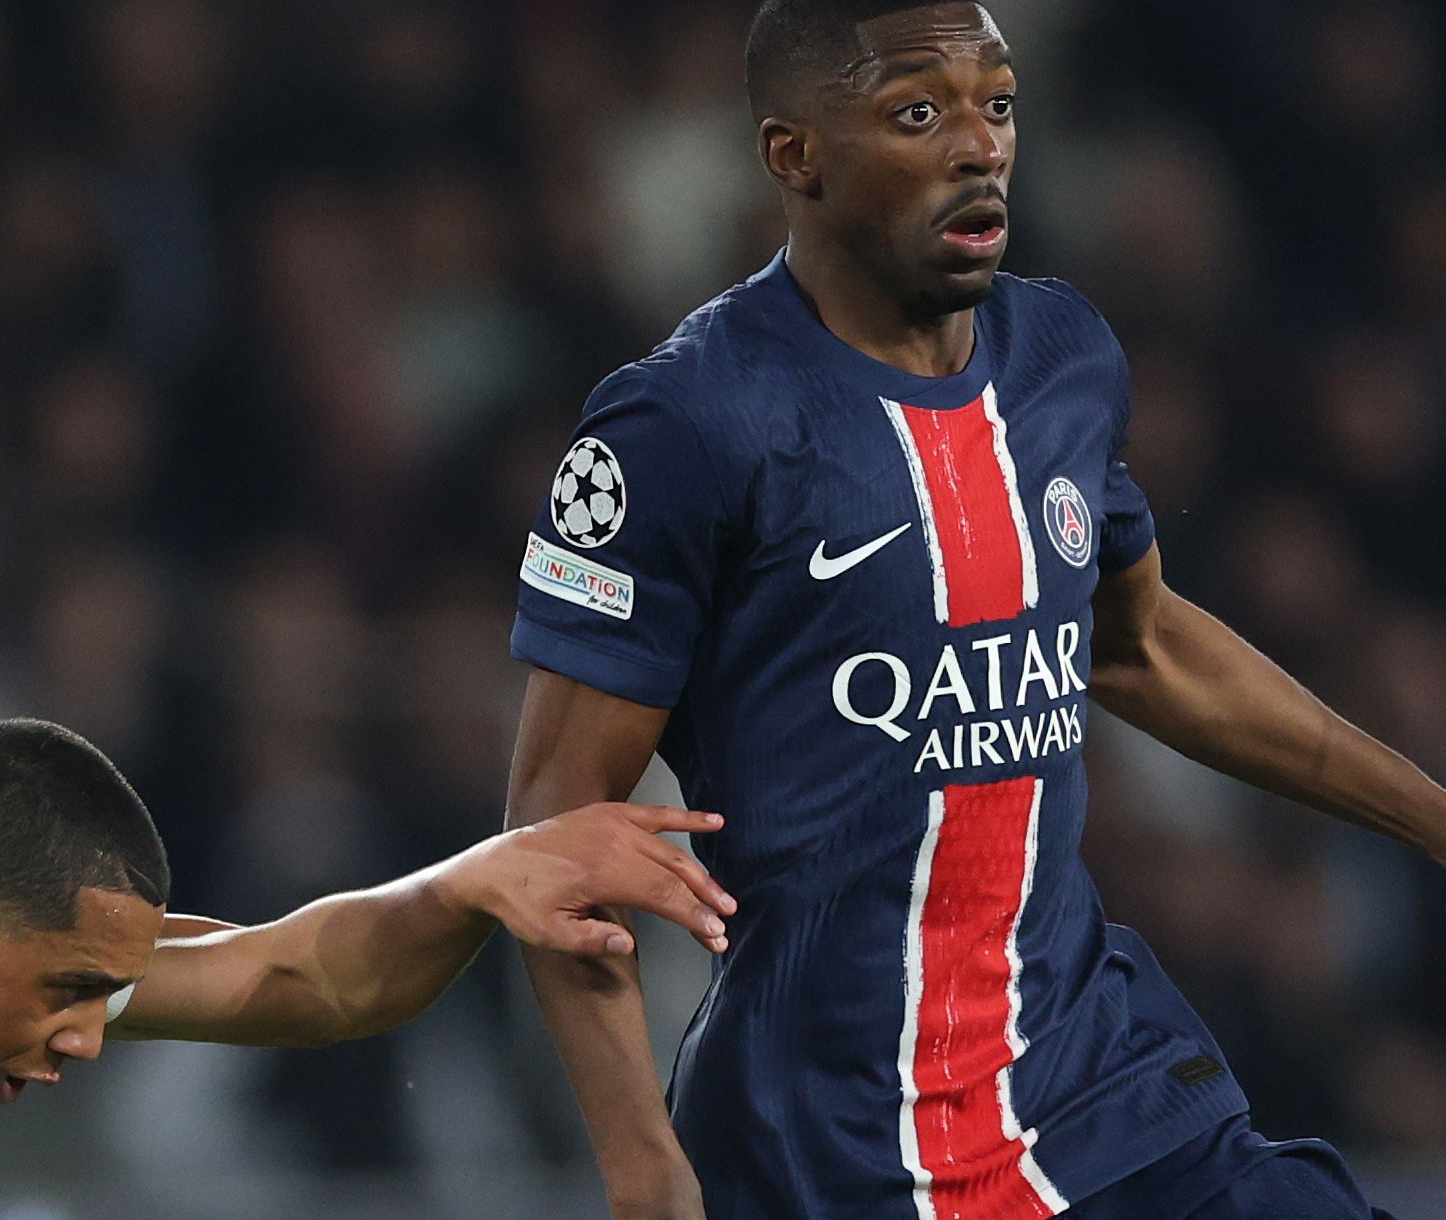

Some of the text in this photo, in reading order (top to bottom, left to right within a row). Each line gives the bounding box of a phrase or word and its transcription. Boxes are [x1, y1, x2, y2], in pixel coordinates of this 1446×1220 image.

[1049, 482, 1078, 504] PARIS
[526, 548, 630, 603] FOUNDATION
[832, 621, 1087, 743] QATAR
[913, 704, 1082, 773] AIRWAYS
